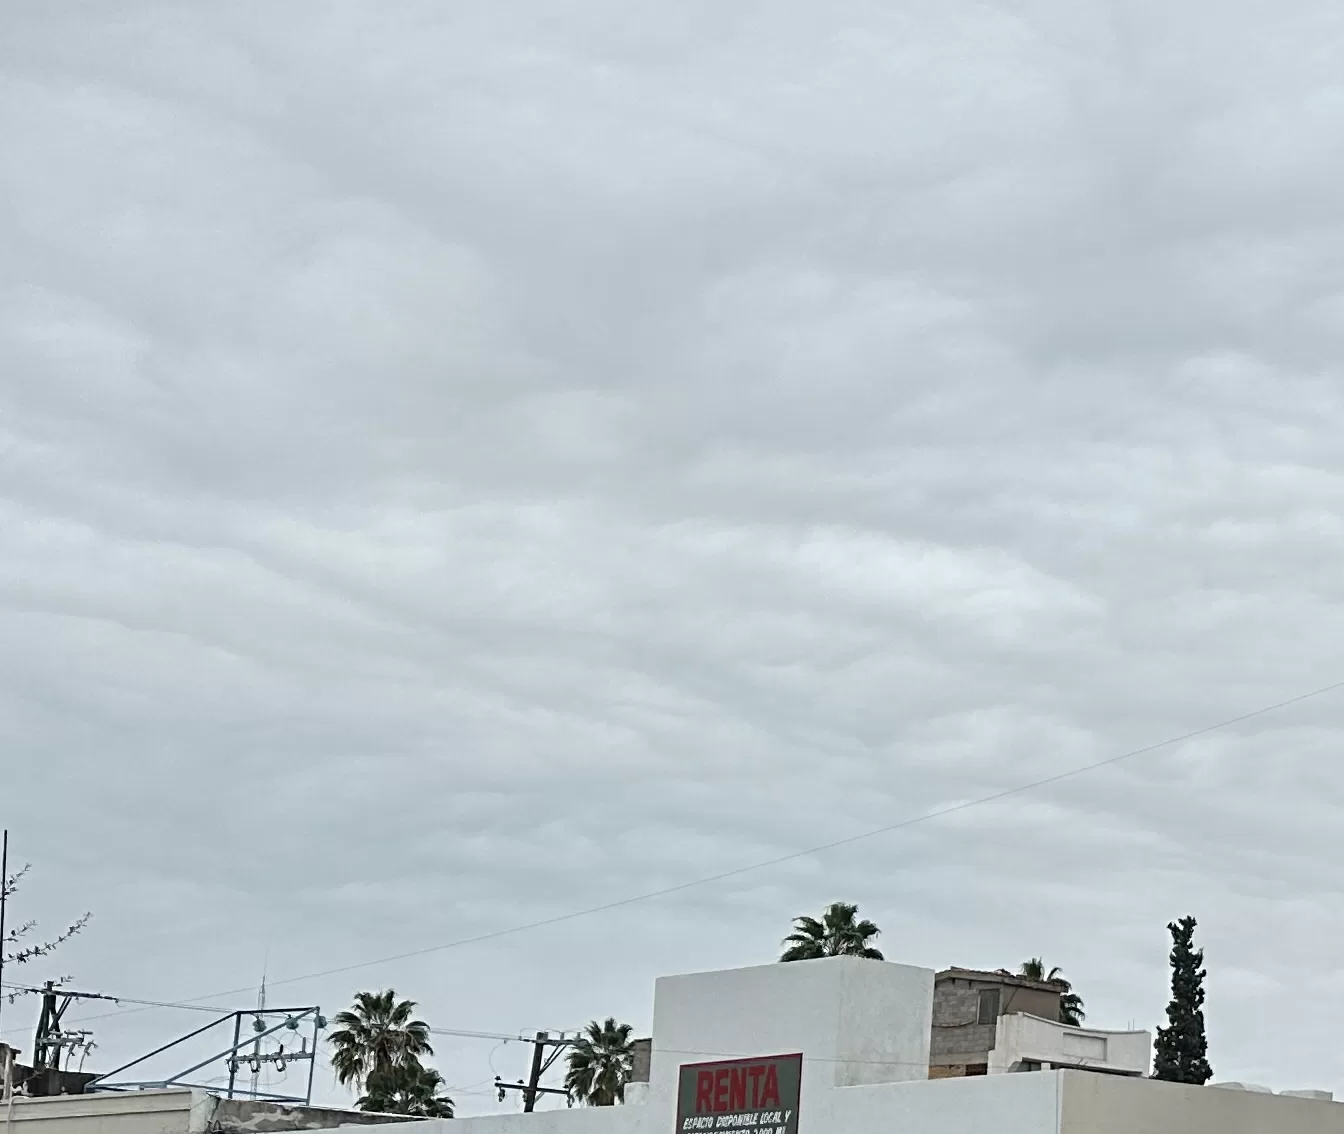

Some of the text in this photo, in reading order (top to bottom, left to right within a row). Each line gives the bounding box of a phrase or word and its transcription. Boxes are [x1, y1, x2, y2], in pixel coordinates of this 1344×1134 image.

[696, 1064, 781, 1113] RENTA
[683, 1110, 792, 1130] ESPACIO DISPONIBLE LOCAL Y
